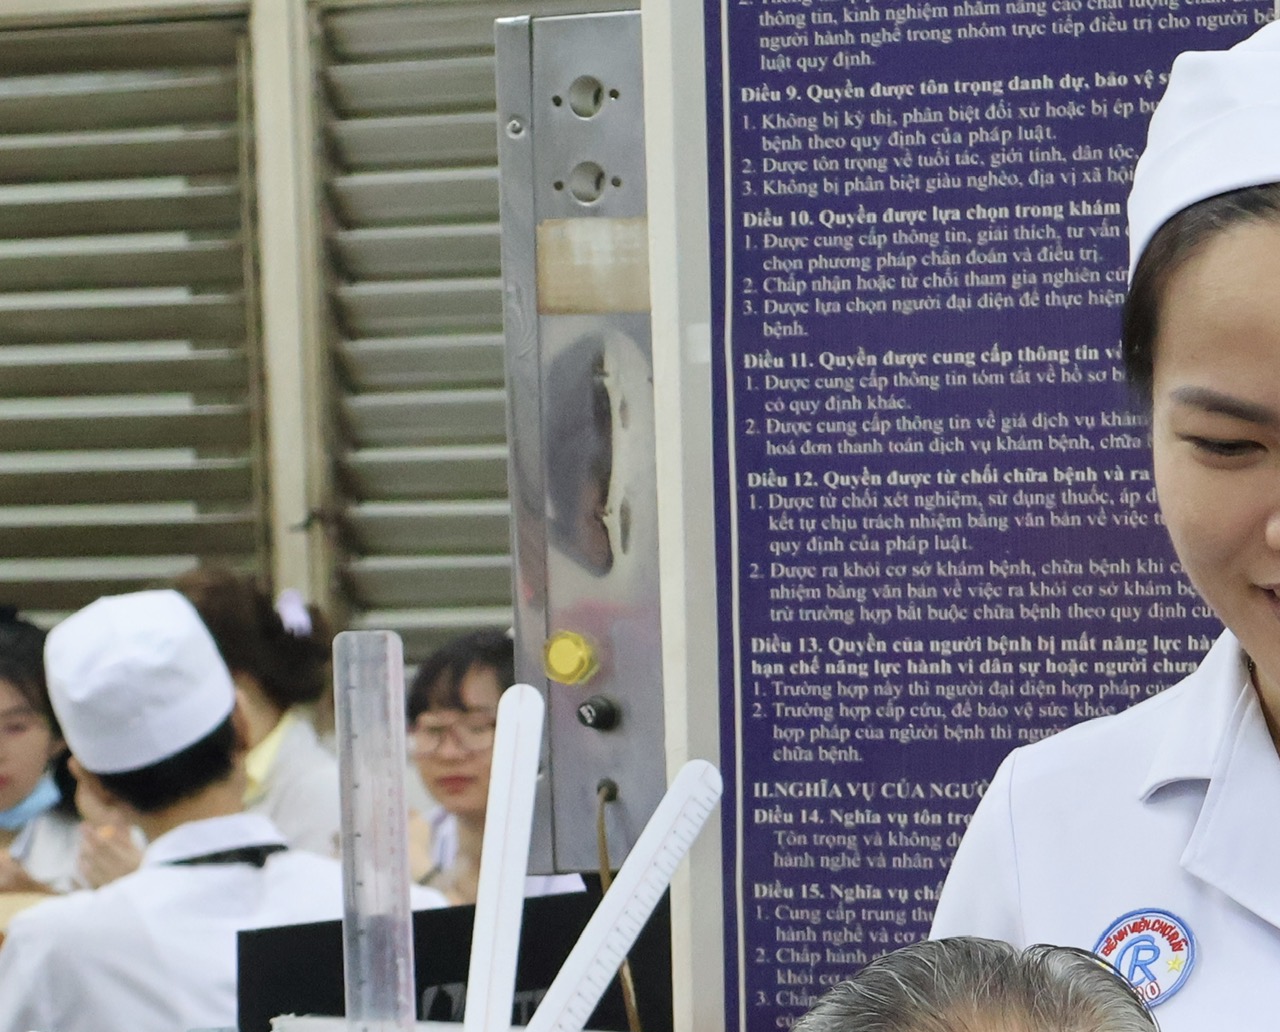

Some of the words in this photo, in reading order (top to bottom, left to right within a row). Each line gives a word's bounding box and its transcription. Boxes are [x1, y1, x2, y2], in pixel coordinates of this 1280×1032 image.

[786, 84, 801, 101] 9.
[870, 79, 914, 100] được
[920, 79, 949, 95] tôn
[954, 78, 1003, 98] trọng
[1008, 73, 1054, 91] danh
[1059, 71, 1090, 92] dự,
[1134, 70, 1154, 89] vệ
[791, 209, 814, 226] 10.
[883, 205, 927, 226] được
[933, 204, 961, 224] lựa
[966, 202, 1009, 223] chọn
[1015, 203, 1064, 222] trong
[1069, 198, 1120, 216] khám
[791, 351, 813, 368] 11.
[882, 349, 927, 369] được
[932, 353, 975, 369] cung
[1018, 345, 1070, 366] thông
[1075, 345, 1099, 360] tin
[795, 470, 818, 487] 12.
[887, 468, 931, 488] được
[937, 469, 957, 484] từ
[1003, 466, 1048, 483] chữa
[1054, 465, 1097, 486] bệnh
[1104, 466, 1124, 481] và
[1130, 470, 1150, 481] ra
[799, 637, 822, 653] 13.
[930, 637, 981, 657] người
[987, 636, 1032, 655] bệnh
[1038, 635, 1055, 655] bị
[1154, 635, 1181, 654] lực
[752, 659, 784, 678] hạn
[874, 658, 901, 678] lực
[907, 658, 952, 674] hành
[958, 659, 974, 674] vi
[979, 658, 1013, 674] dân
[1019, 663, 1041, 677] sự
[1046, 657, 1088, 677] hoặc
[1094, 658, 1147, 678] người
[754, 778, 842, 798] II.NGHĨA
[847, 782, 874, 802] VỤ
[881, 778, 924, 798] CỦA
[930, 778, 988, 798] NGƯỜ
[801, 808, 824, 824] 14.
[830, 809, 881, 829] Nghĩa
[887, 815, 908, 829] vụ
[913, 810, 942, 825] tôn
[802, 884, 824, 900] 15.
[831, 884, 882, 905] Nghĩa
[888, 890, 908, 904] vụ
